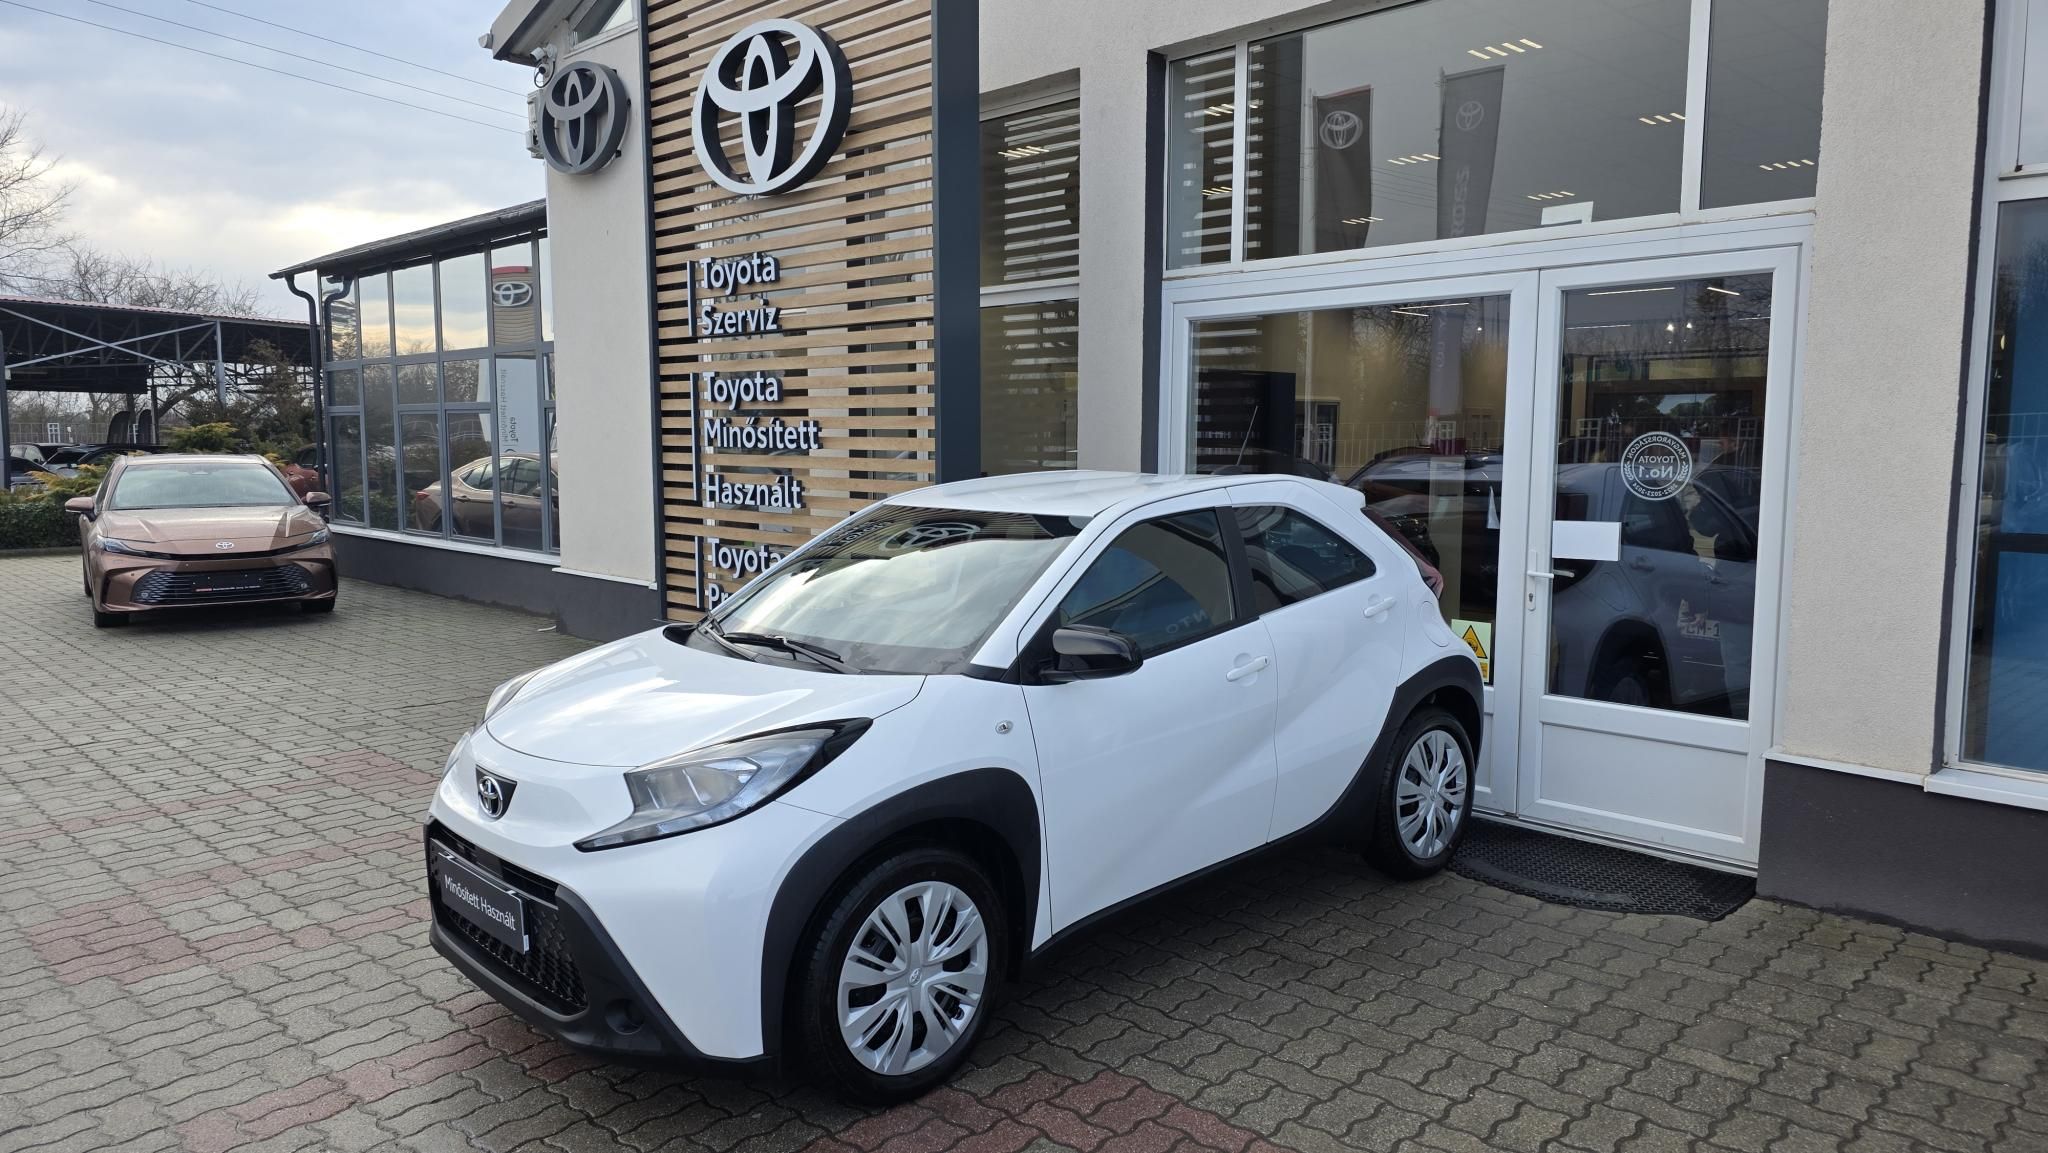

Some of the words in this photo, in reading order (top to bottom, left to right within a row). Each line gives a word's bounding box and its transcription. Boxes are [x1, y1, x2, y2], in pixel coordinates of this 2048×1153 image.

[701, 252, 777, 295] Toyota
[702, 299, 778, 336] Szerviz
[703, 371, 781, 409] Toyota
[704, 417, 820, 450] Minősített
[705, 473, 803, 509] Használt
[444, 874, 480, 910] Minősített
[480, 896, 516, 932] Használt
